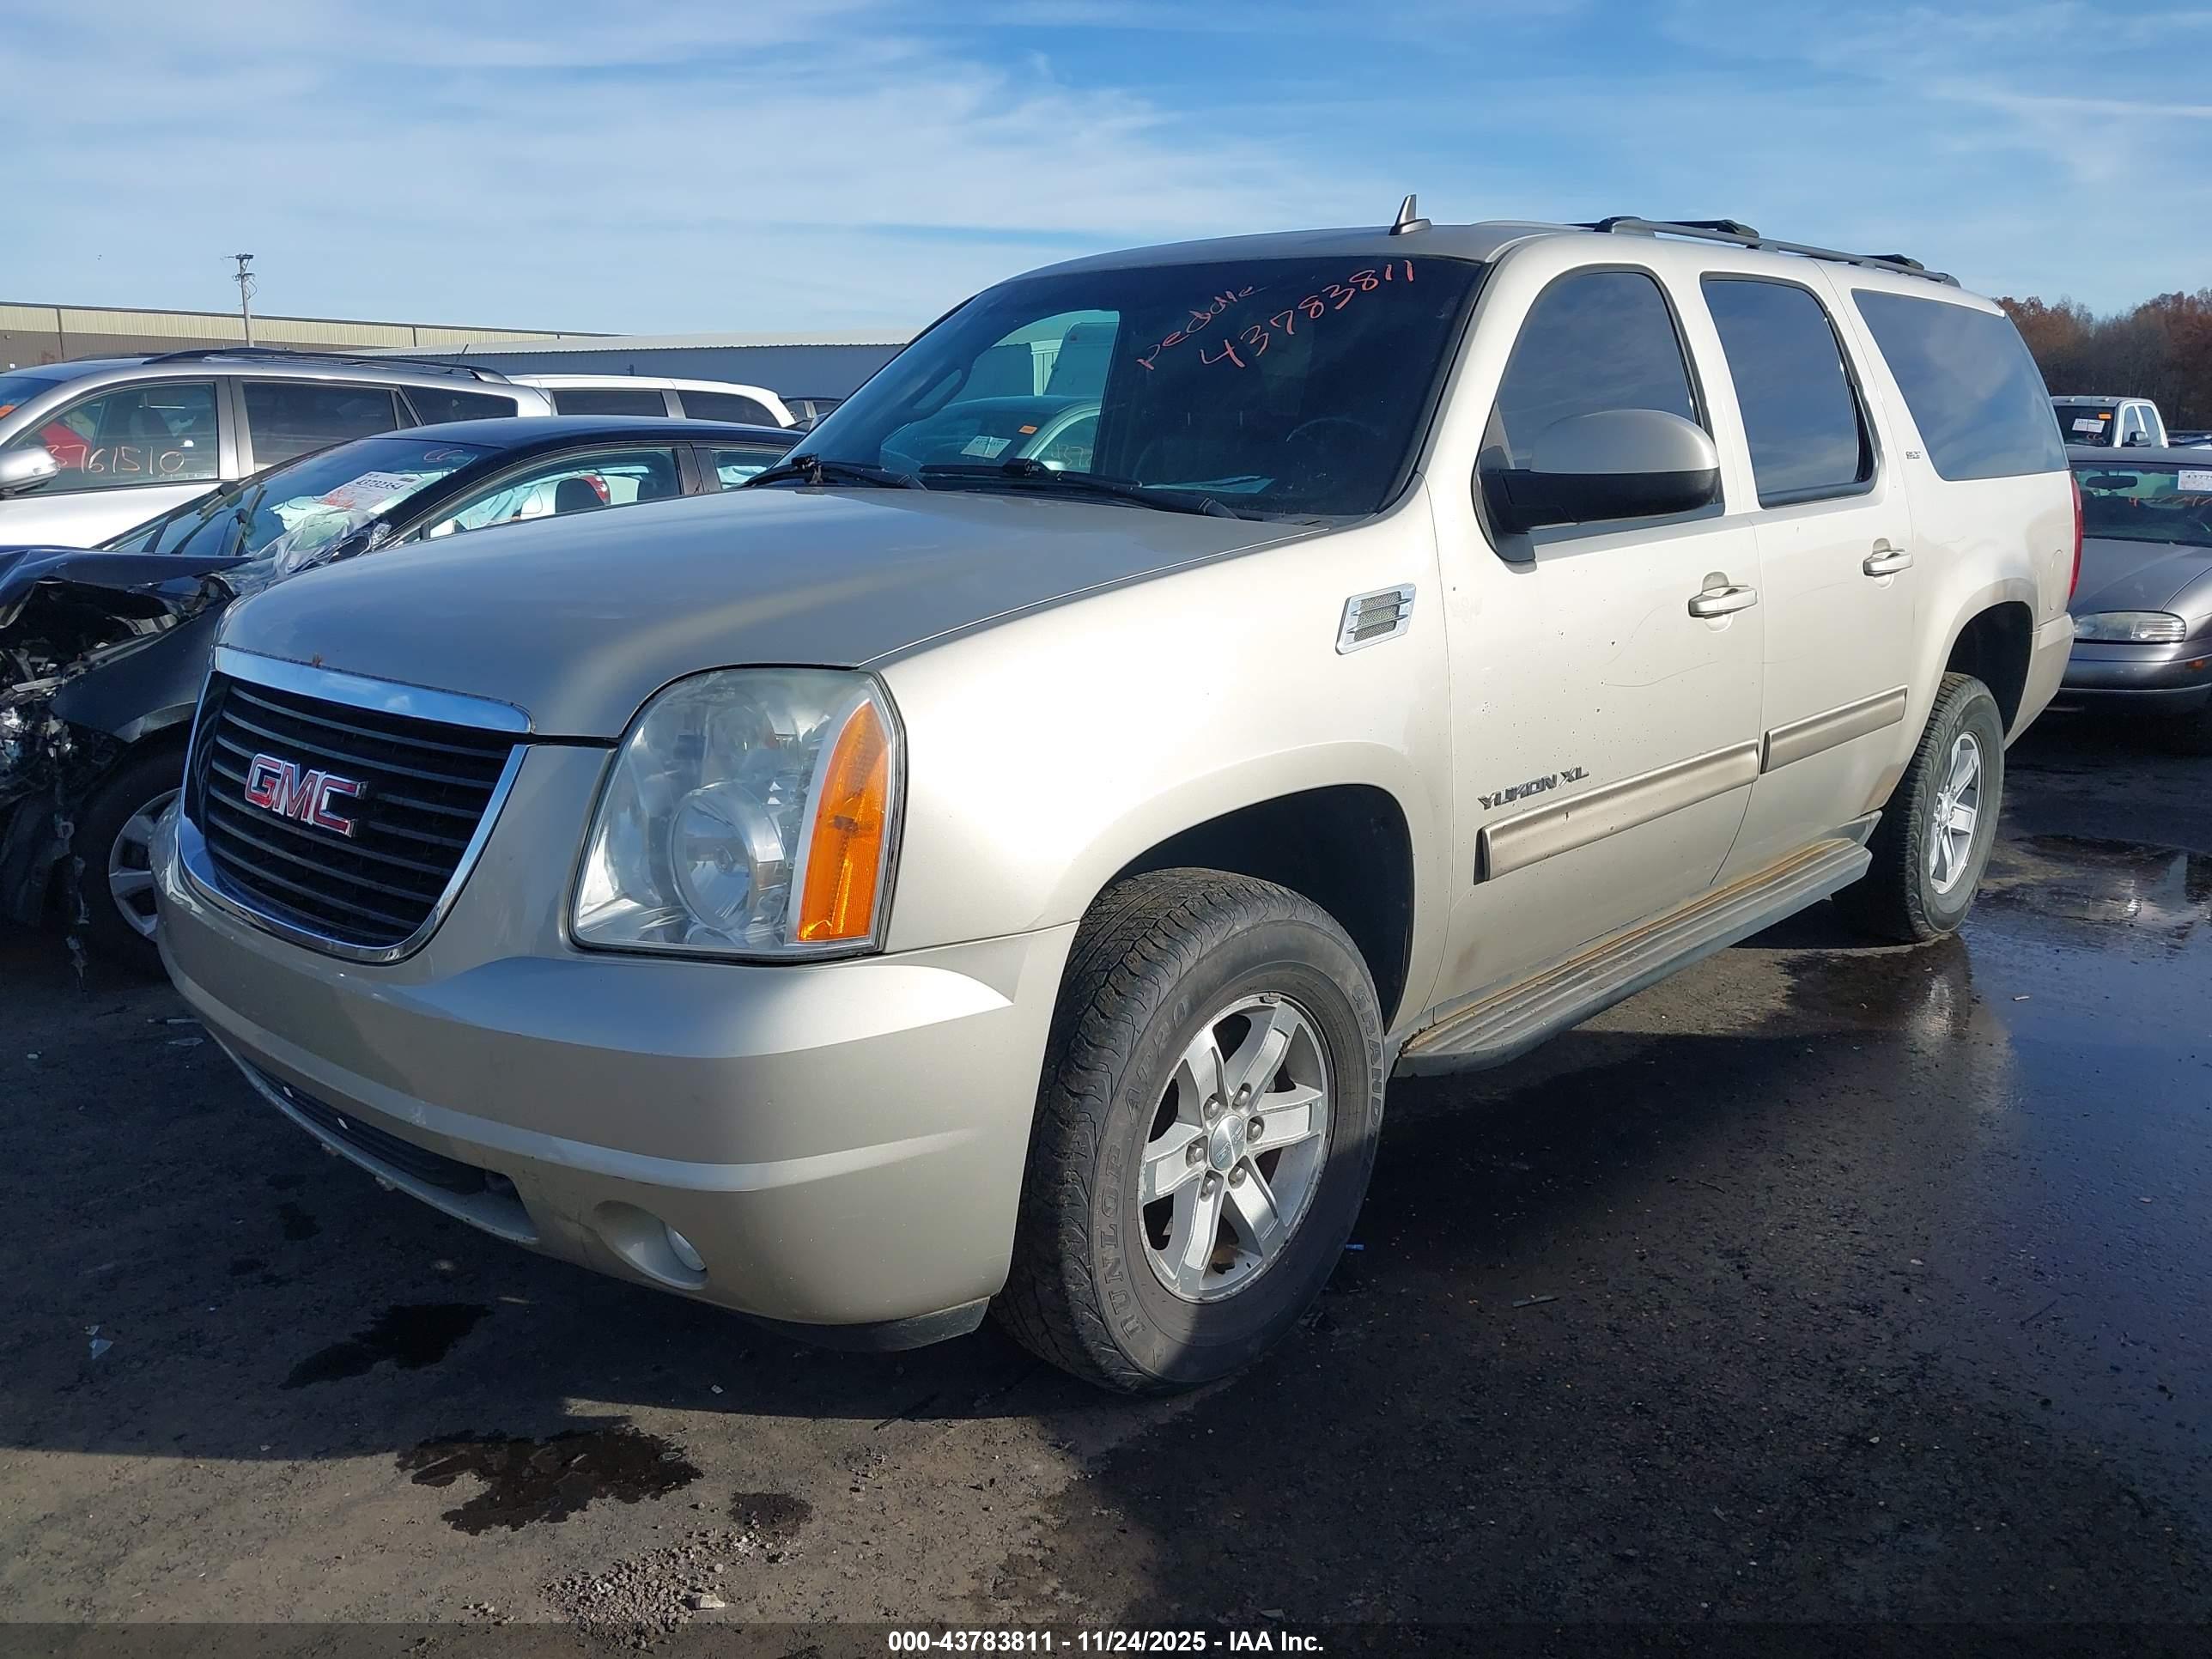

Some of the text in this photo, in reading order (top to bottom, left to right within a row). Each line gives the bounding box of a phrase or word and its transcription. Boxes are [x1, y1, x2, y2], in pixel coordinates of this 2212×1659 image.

[1200, 260, 1415, 368] 43783811
[245, 753, 369, 838] GMC
[1477, 765, 1589, 811] YUKON XL
[1215, 1124, 1243, 1163] GMC
[1100, 1145, 1146, 1340] DUNLOP
